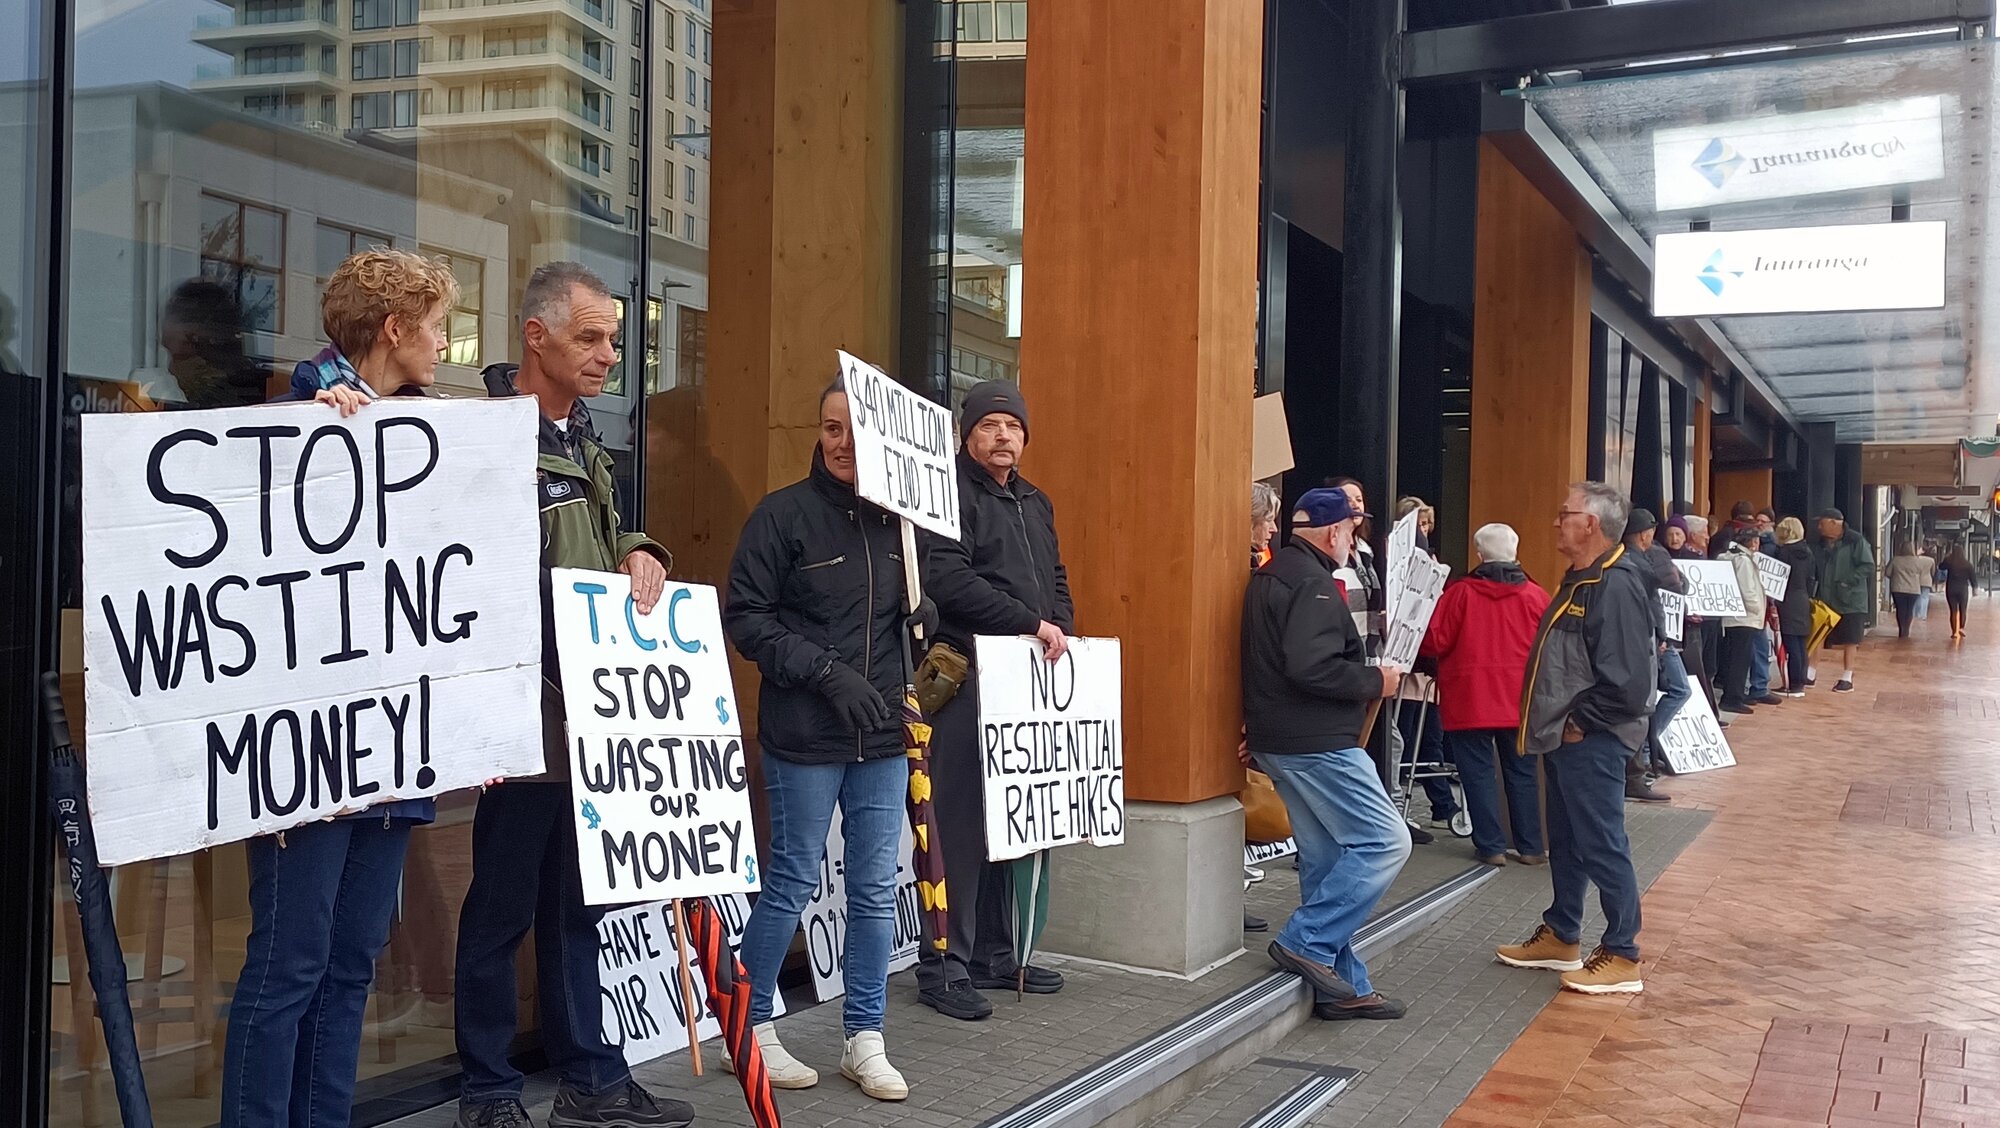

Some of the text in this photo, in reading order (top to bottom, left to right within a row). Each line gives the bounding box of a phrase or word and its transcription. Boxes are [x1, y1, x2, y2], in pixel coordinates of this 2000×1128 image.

[850, 361, 947, 459] $40 MILLION
[146, 416, 440, 569] STOP
[884, 444, 955, 527] FIND IT!
[100, 543, 479, 697] WASTING
[573, 582, 708, 653] T.C.C.
[1687, 583, 1741, 599] DENTIAL
[593, 664, 691, 720] STOP
[1029, 646, 1075, 712] NO
[206, 674, 437, 831] MONEY!
[578, 737, 747, 793] WASTING
[985, 719, 1123, 778] RESIDENTIAL
[650, 793, 700, 818] OUR
[1006, 774, 1123, 846] RATE HIKES
[601, 820, 742, 889] MONEY
[600, 911, 661, 971] HAVE
[600, 974, 661, 1050] OUR
